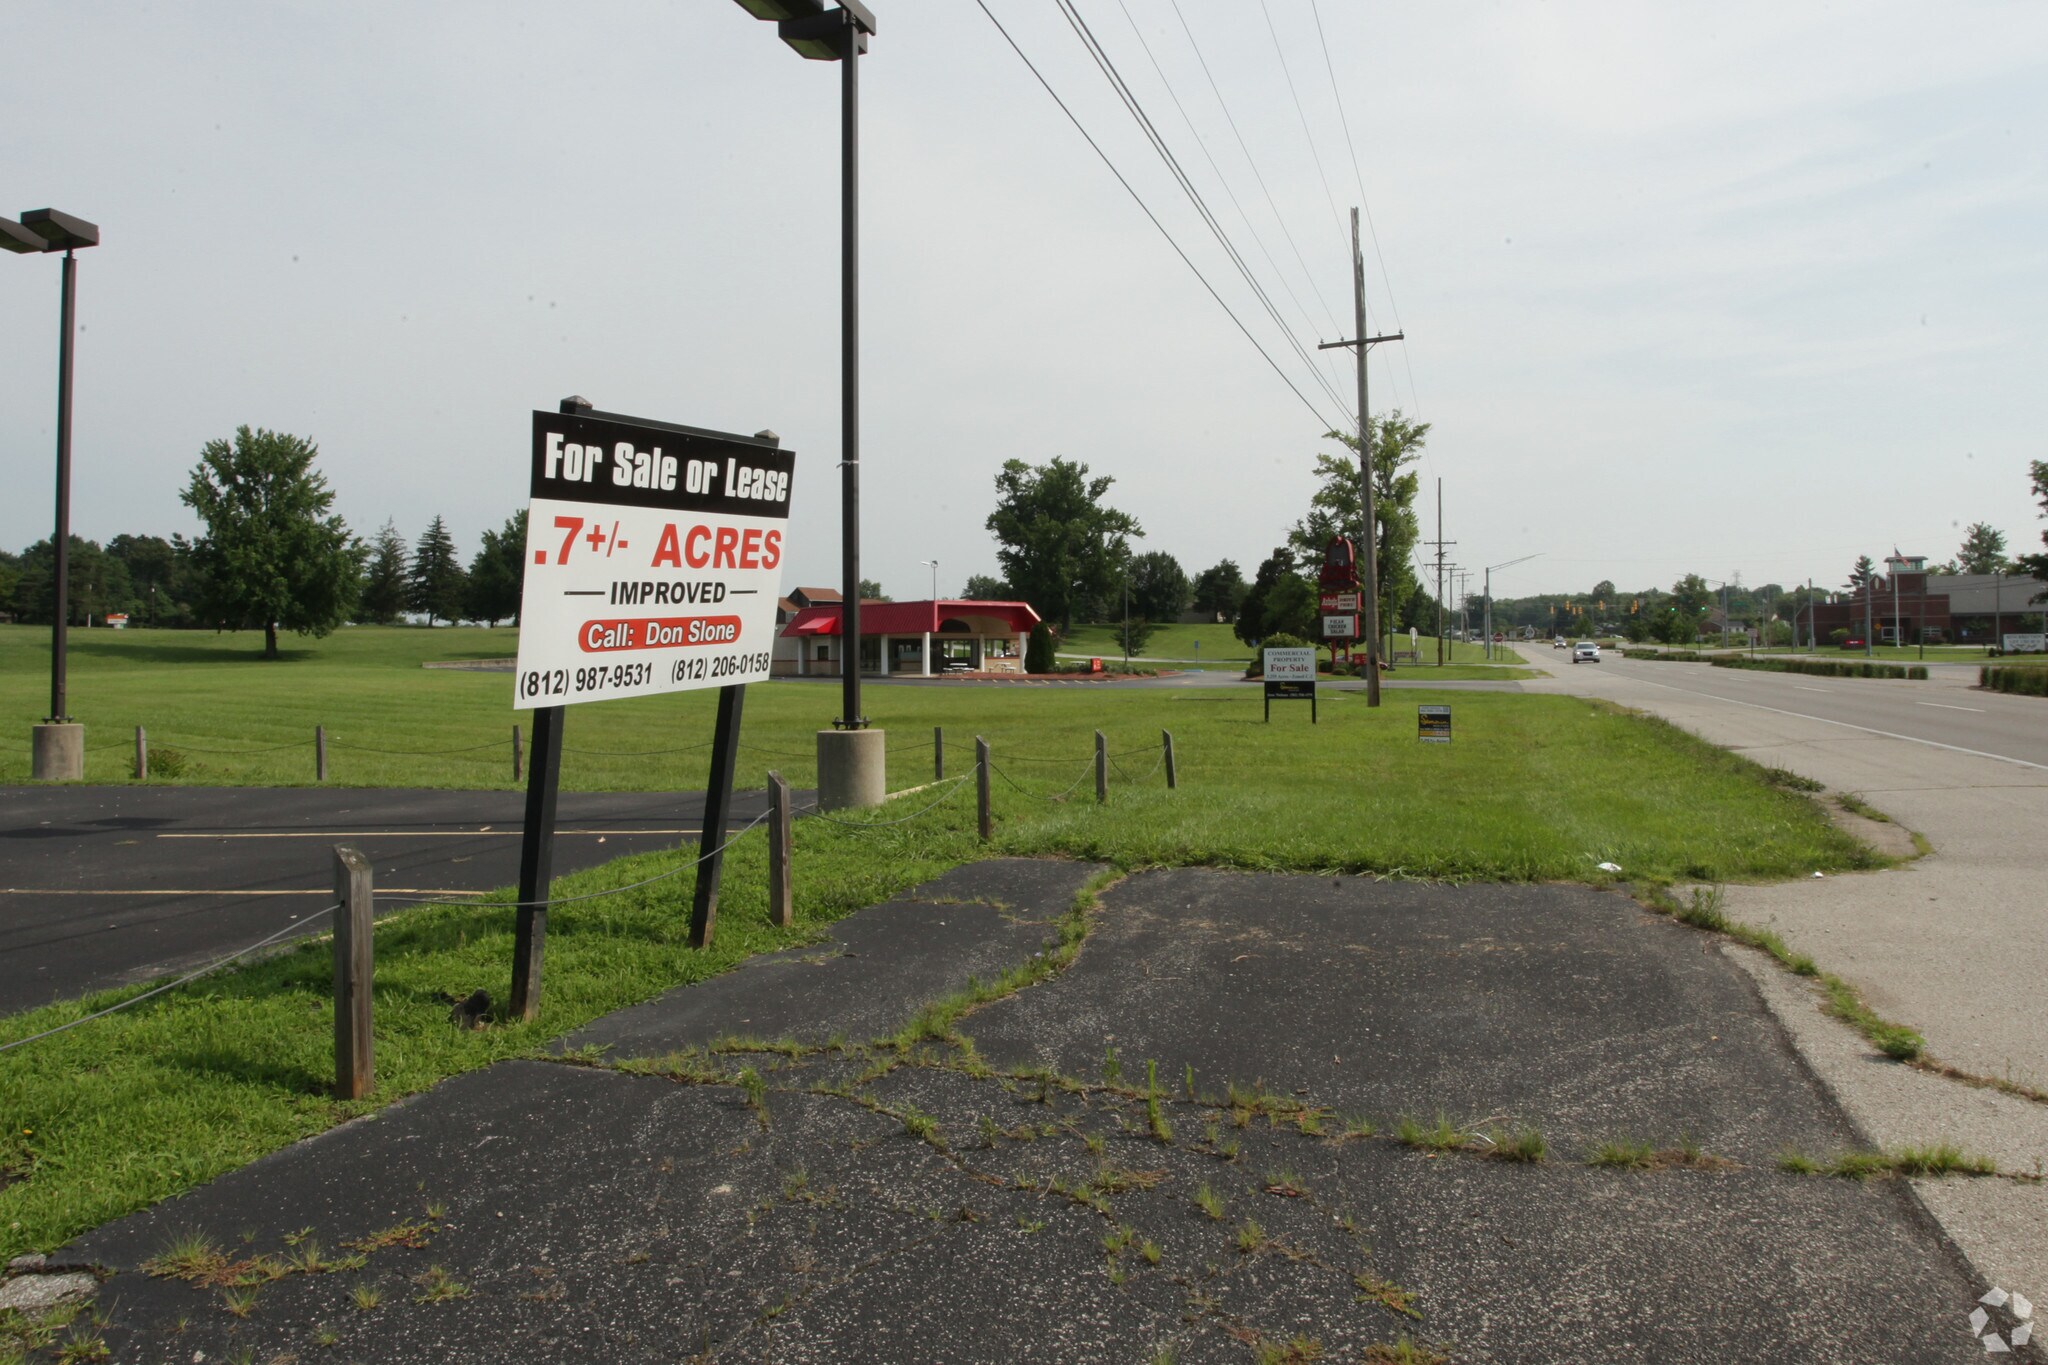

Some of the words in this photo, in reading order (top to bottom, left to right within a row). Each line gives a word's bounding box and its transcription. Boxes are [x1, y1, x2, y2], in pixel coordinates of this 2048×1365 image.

[544, 432, 603, 483] For
[612, 441, 678, 491] Sale
[685, 459, 718, 495] or
[724, 457, 789, 503] Lease
[651, 523, 782, 570] ACRES
[610, 581, 726, 605] IMPROVED
[587, 622, 634, 649] Call:
[645, 621, 682, 646] Don
[687, 619, 735, 644] Slone
[520, 667, 570, 700] (812)
[575, 662, 653, 692] 987-9531
[671, 657, 708, 685] (812)
[711, 652, 770, 678] 206-0158
[1270, 664, 1287, 672] For
[1289, 664, 1309, 672] Sale
